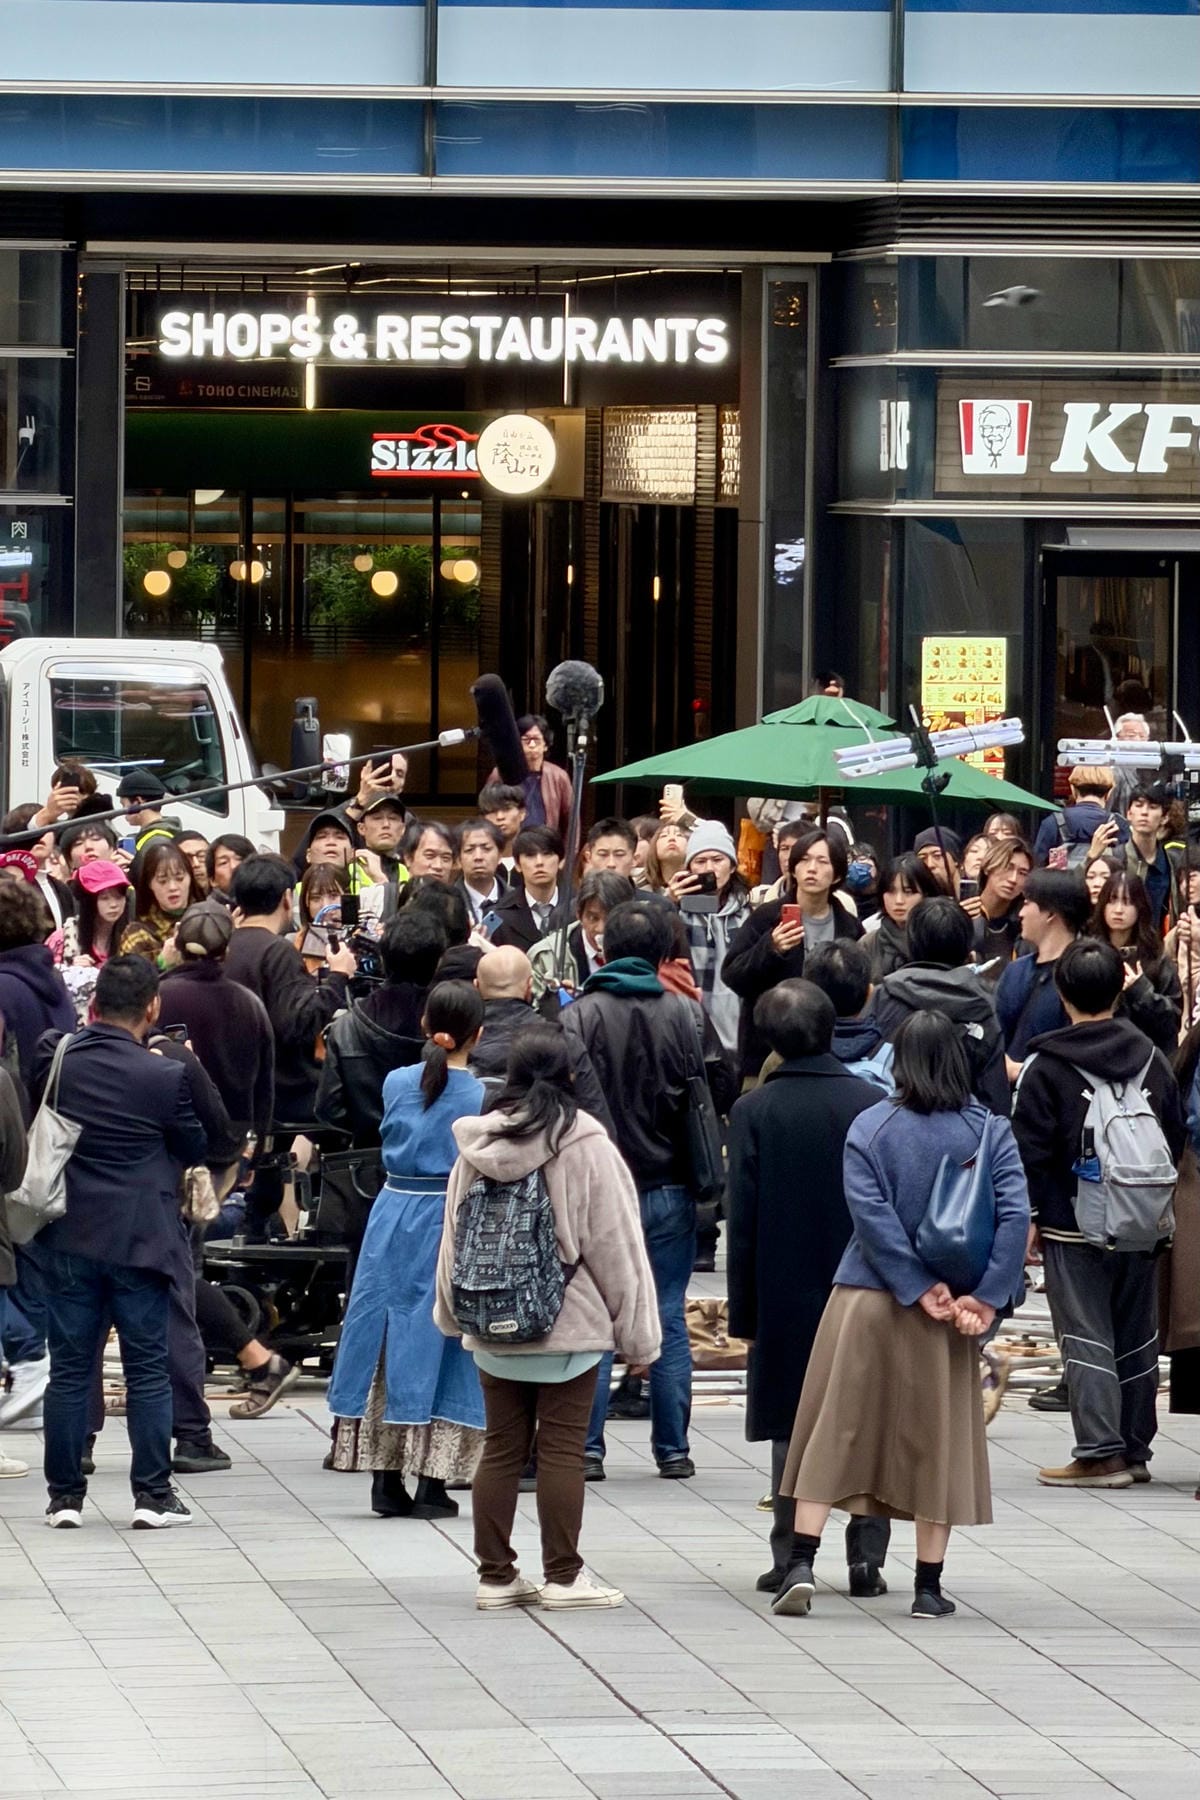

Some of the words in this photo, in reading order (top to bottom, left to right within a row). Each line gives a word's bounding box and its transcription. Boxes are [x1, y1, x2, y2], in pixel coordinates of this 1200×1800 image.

[159, 311, 322, 357] SHOPS
[329, 314, 368, 359] &
[376, 315, 728, 363] RESTAURANTS
[197, 384, 235, 397] TOHO
[238, 384, 299, 397] CINEMAS
[1050, 402, 1200, 473] KF
